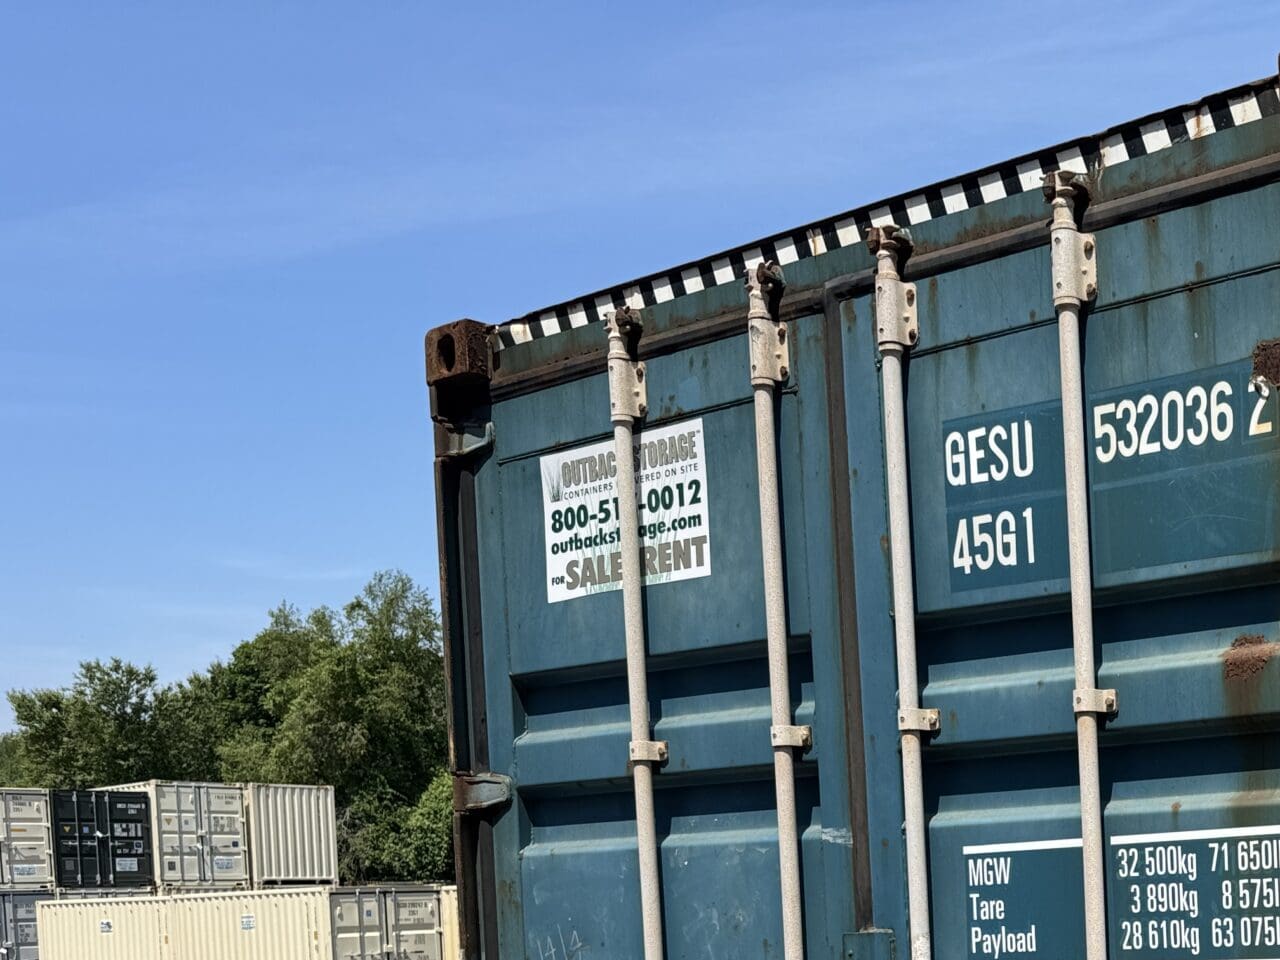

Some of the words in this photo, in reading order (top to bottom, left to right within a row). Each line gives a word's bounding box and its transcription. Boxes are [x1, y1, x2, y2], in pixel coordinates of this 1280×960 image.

[944, 419, 1034, 487] GESU
[1093, 380, 1234, 464] 532036
[1247, 374, 1273, 437] 2
[561, 450, 618, 489] OUTBAC
[563, 482, 613, 500] CONTAINERS
[664, 468, 677, 479] ON
[680, 463, 699, 474] SITE
[551, 479, 702, 534] 800-51-0012
[551, 513, 702, 555] outbackstage.com
[952, 506, 1036, 575] 45G1
[551, 576, 566, 587] FOR
[565, 551, 623, 591] SALE
[639, 535, 708, 577] RENT
[967, 856, 1011, 887] MGW
[1118, 847, 1140, 878] 32
[1145, 845, 1198, 881] 500kg
[1208, 843, 1229, 873] 71
[970, 893, 1006, 921] Tare
[1130, 884, 1141, 914] 3
[1146, 883, 1199, 918] 890kg
[1221, 880, 1232, 910] 8
[971, 925, 1037, 959] Payload
[1121, 921, 1143, 950] 28
[1148, 919, 1201, 955] 610kg
[1211, 917, 1234, 948] 63
